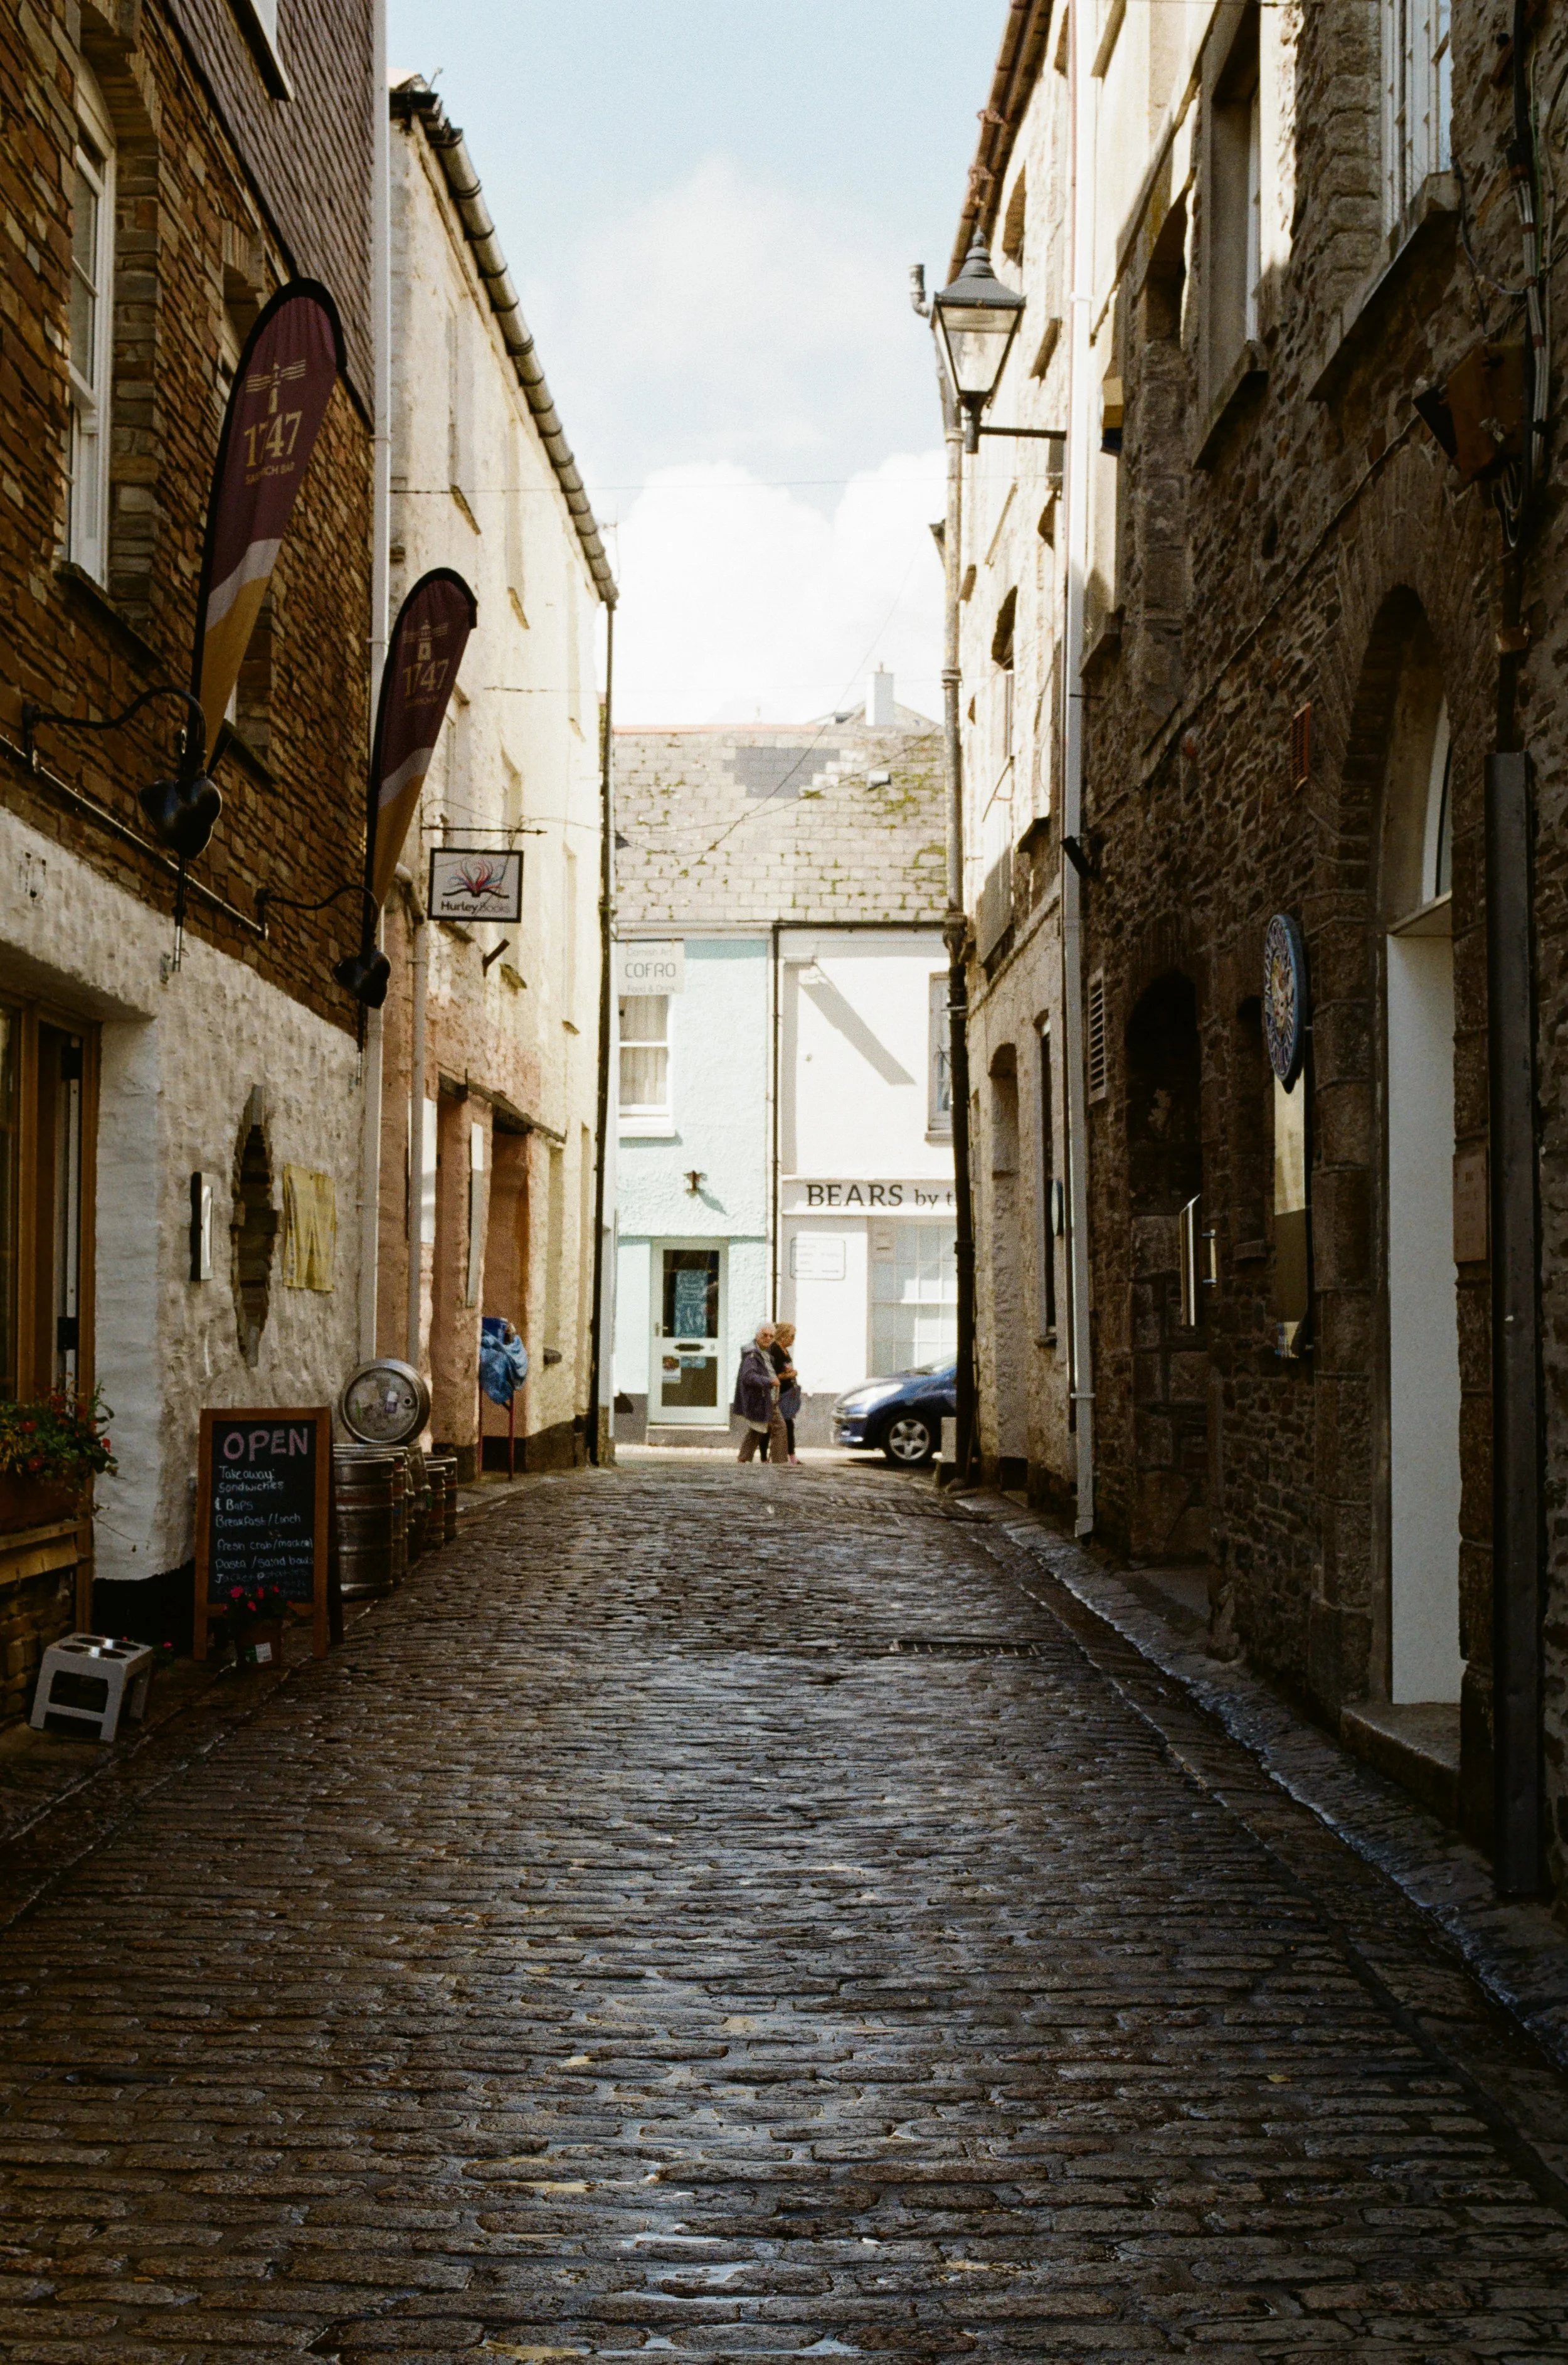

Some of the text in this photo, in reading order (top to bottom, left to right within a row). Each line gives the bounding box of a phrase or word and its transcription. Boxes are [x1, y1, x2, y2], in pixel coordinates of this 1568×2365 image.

[244, 410, 303, 467] 1747
[403, 659, 450, 696] 1747
[625, 962, 677, 979] COFRO
[806, 1184, 903, 1207] BEARS
[914, 1189, 940, 1210] by
[223, 1428, 309, 1462] OPEN
